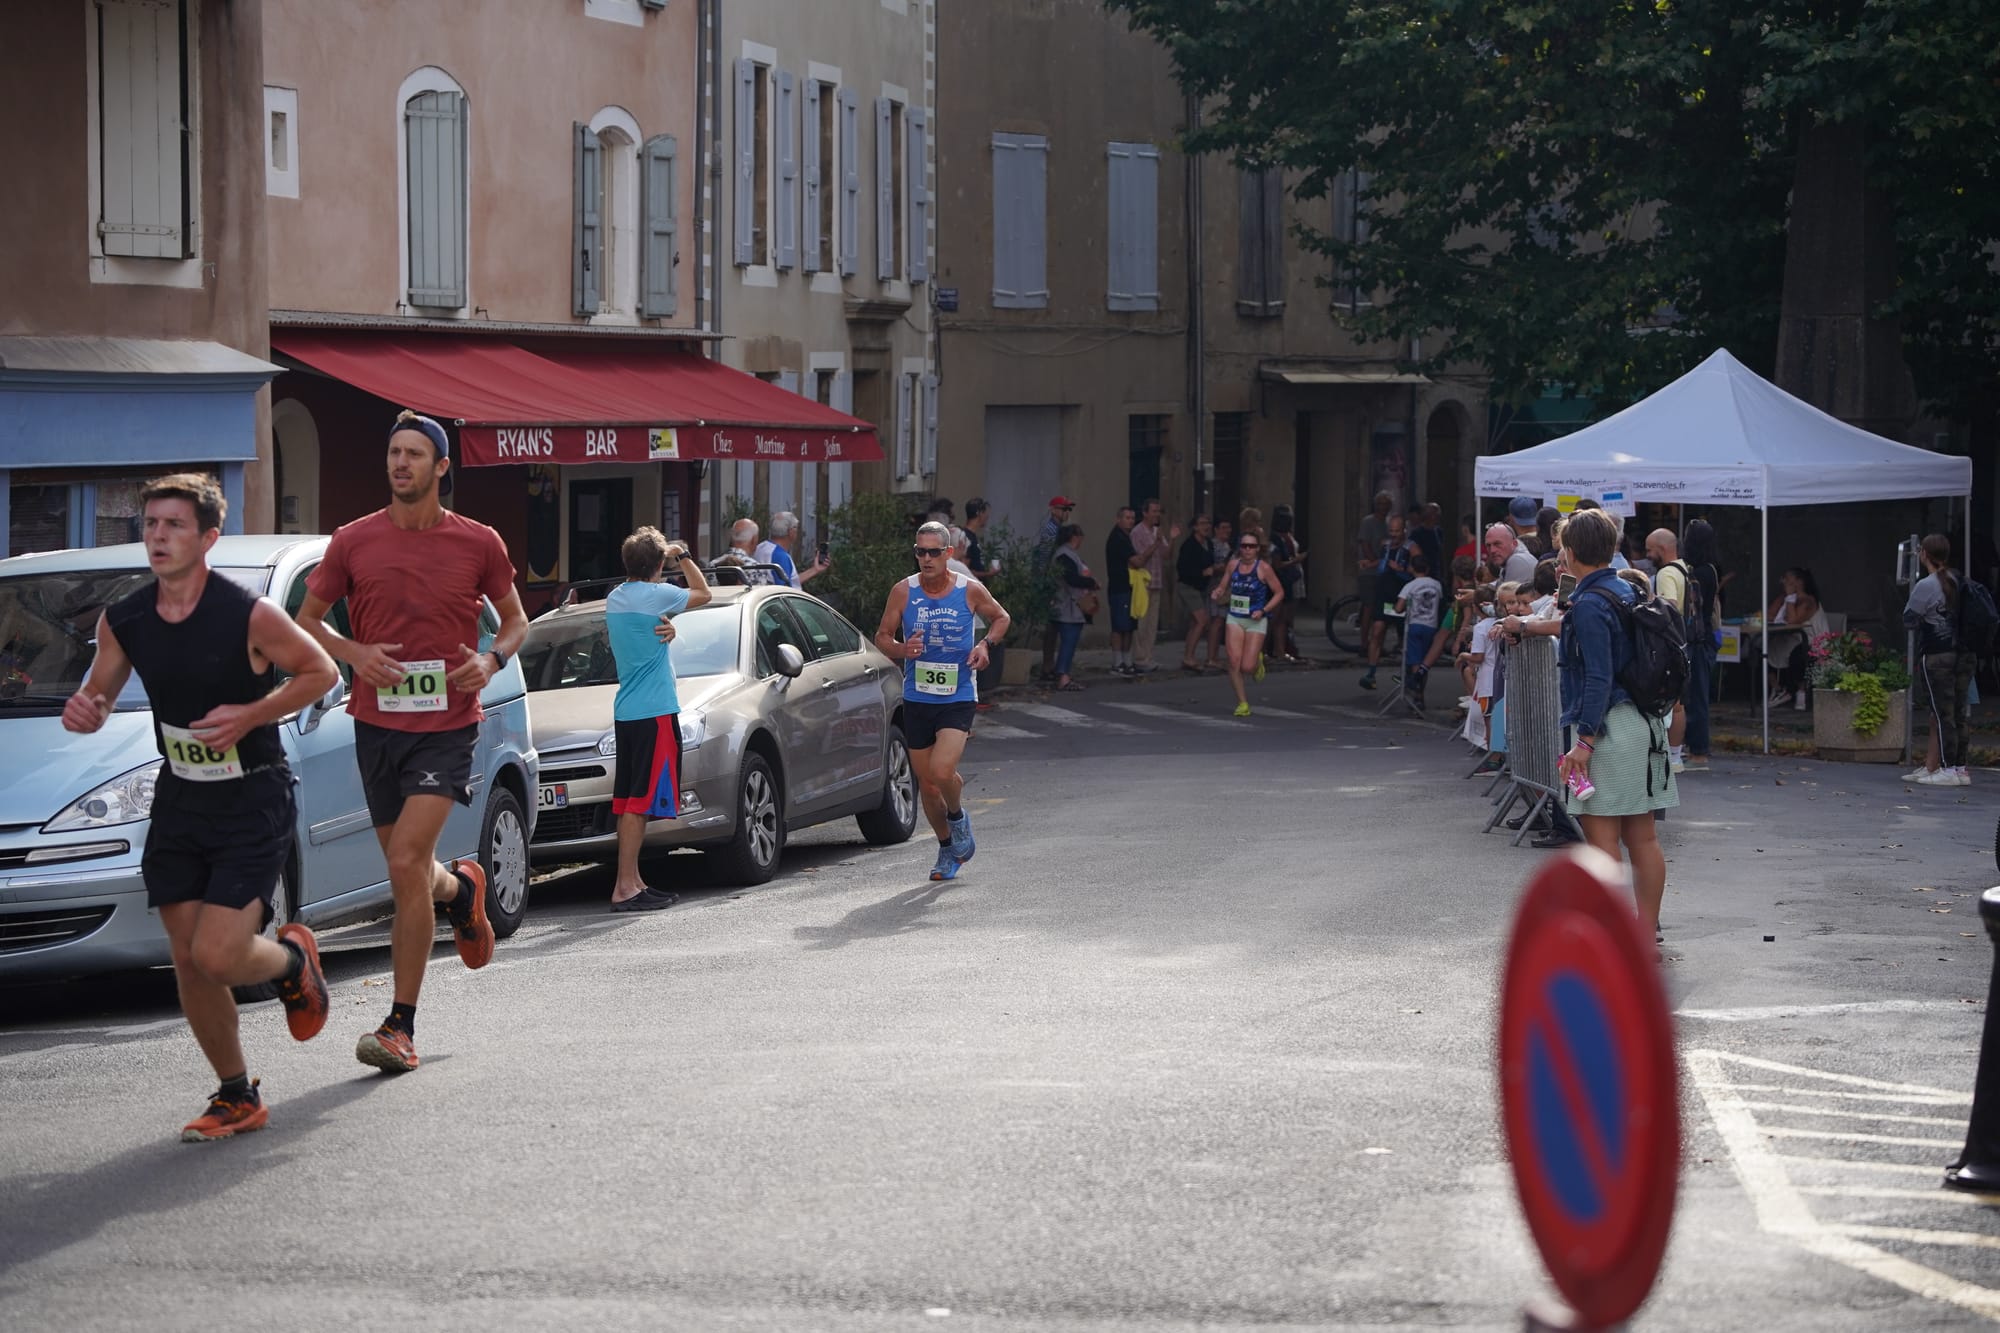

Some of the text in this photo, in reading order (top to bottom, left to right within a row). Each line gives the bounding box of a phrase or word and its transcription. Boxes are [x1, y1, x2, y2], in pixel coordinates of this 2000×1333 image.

[497, 428, 618, 457] RYAN'S BAR
[713, 430, 842, 460] Chez Martine et John
[925, 671, 946, 684] 36
[173, 741, 225, 764] 186
